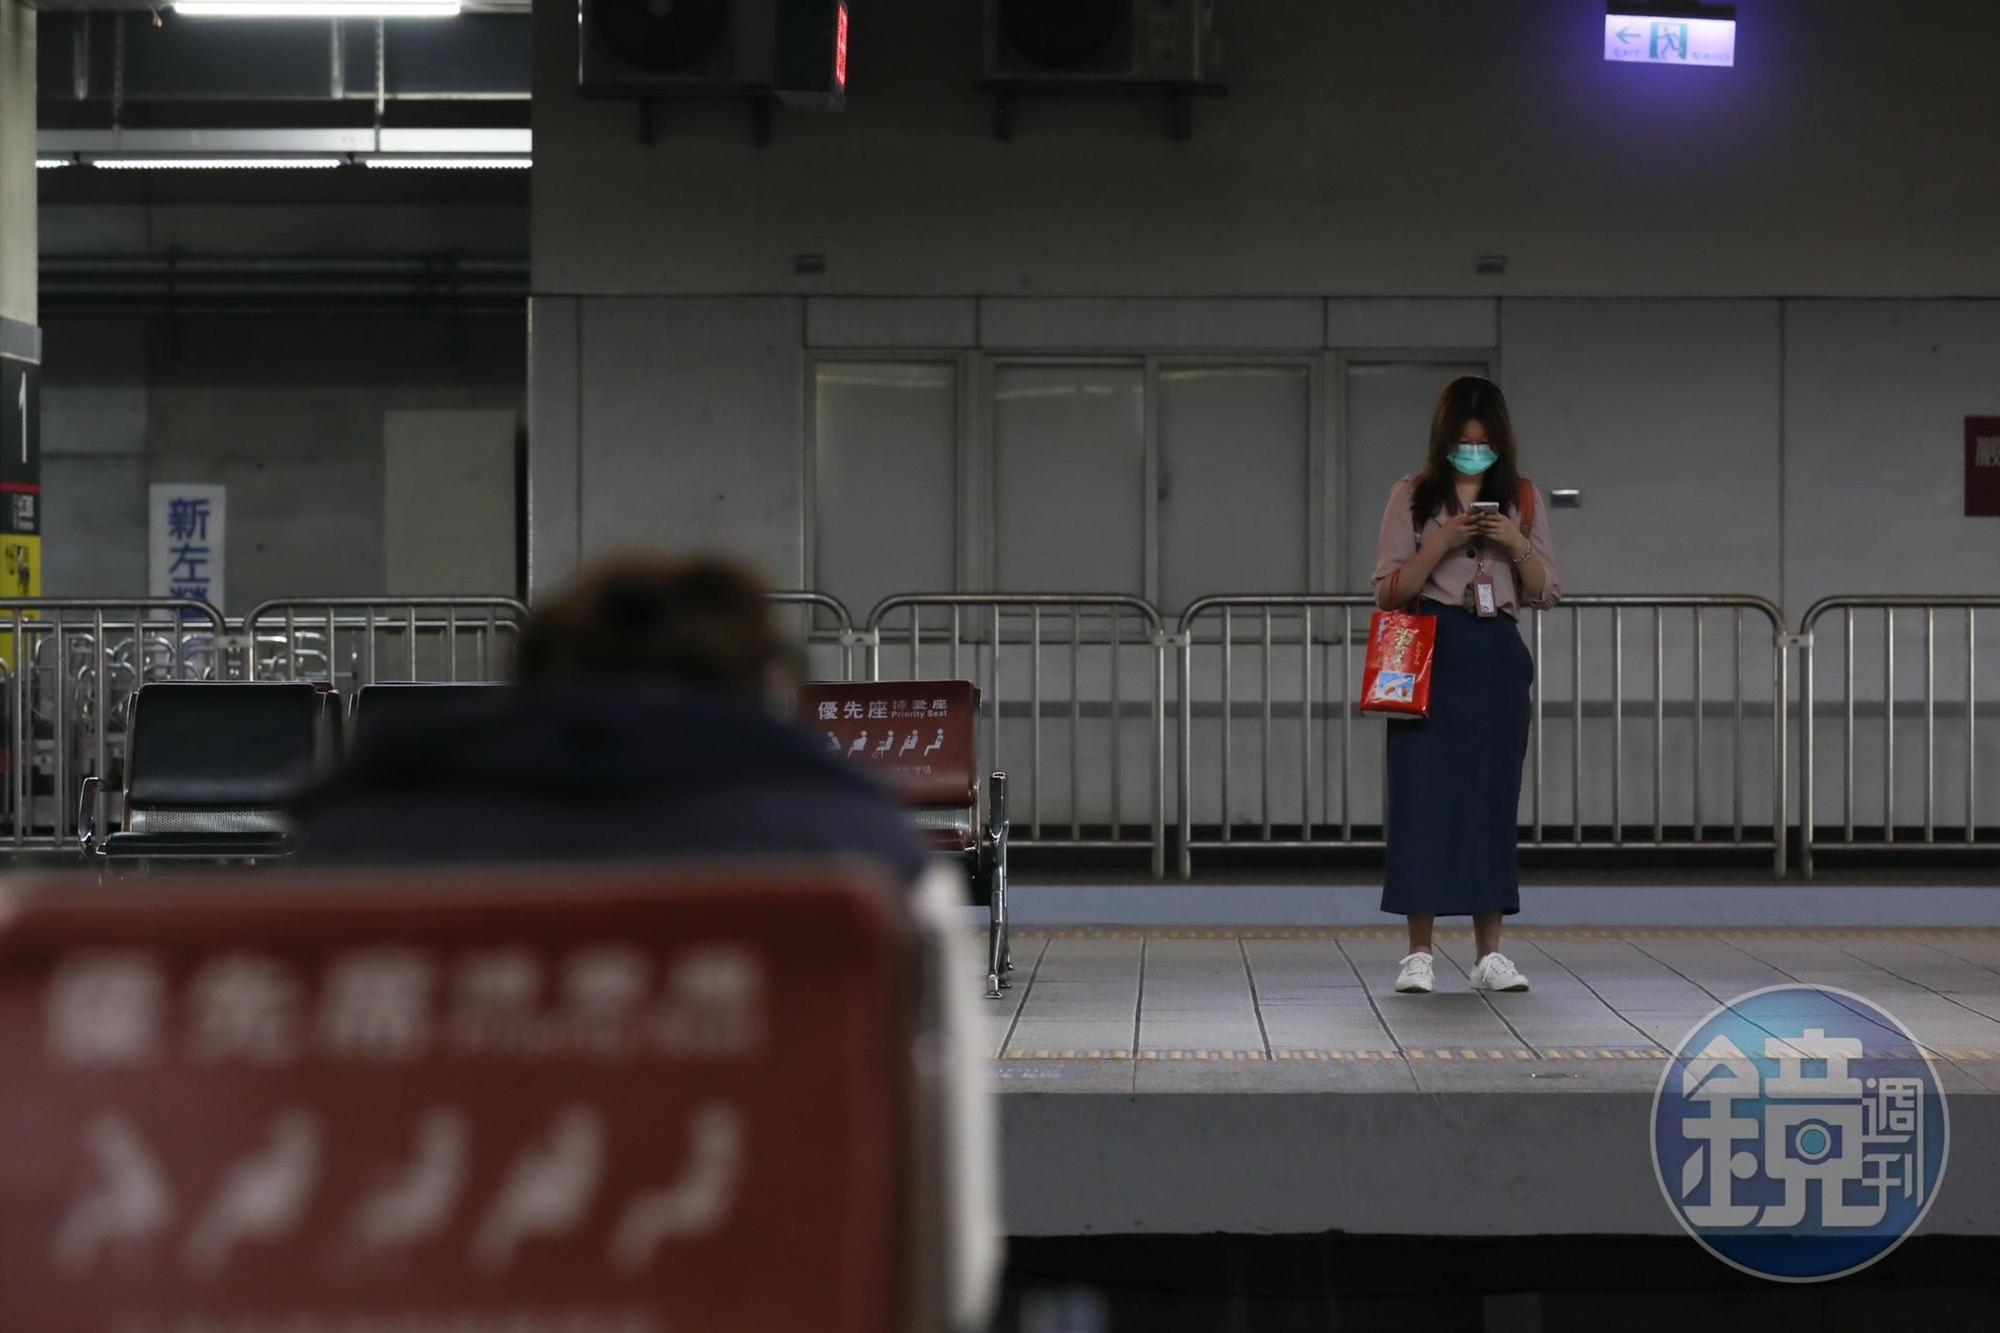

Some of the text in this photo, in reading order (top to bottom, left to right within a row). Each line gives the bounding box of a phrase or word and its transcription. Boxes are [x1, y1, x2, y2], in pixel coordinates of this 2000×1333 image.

[818, 701, 888, 719] 優先座
[892, 708, 948, 718] Priority Seat
